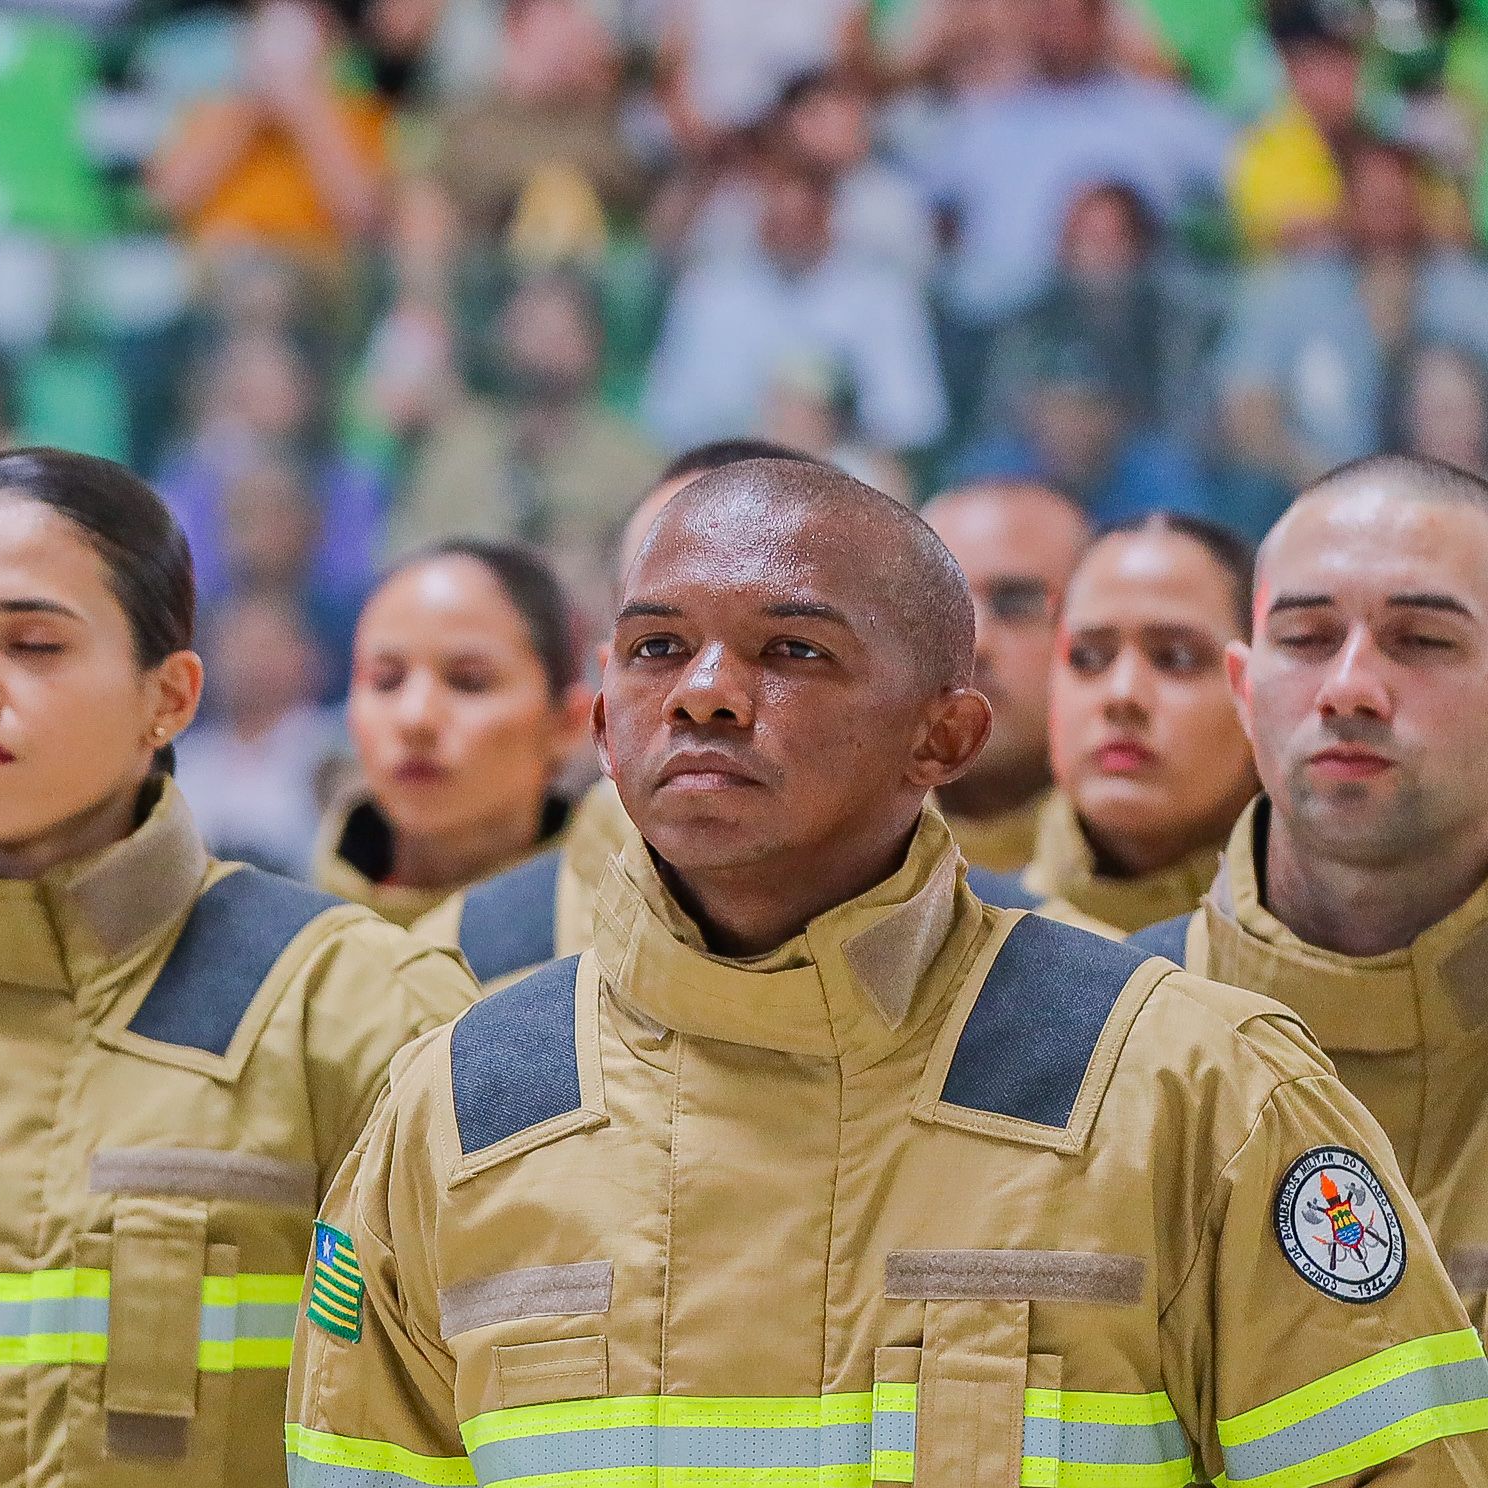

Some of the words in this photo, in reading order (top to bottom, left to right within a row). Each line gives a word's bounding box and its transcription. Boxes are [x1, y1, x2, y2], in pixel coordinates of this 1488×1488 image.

[1299, 1153, 1335, 1176] MILITAR
[1342, 1155, 1357, 1168] DO
[1279, 1174, 1301, 1241] BOMBEIROS
[1387, 1212, 1396, 1229] DO
[1288, 1244, 1303, 1260] DE
[1302, 1262, 1338, 1291] CORPO
